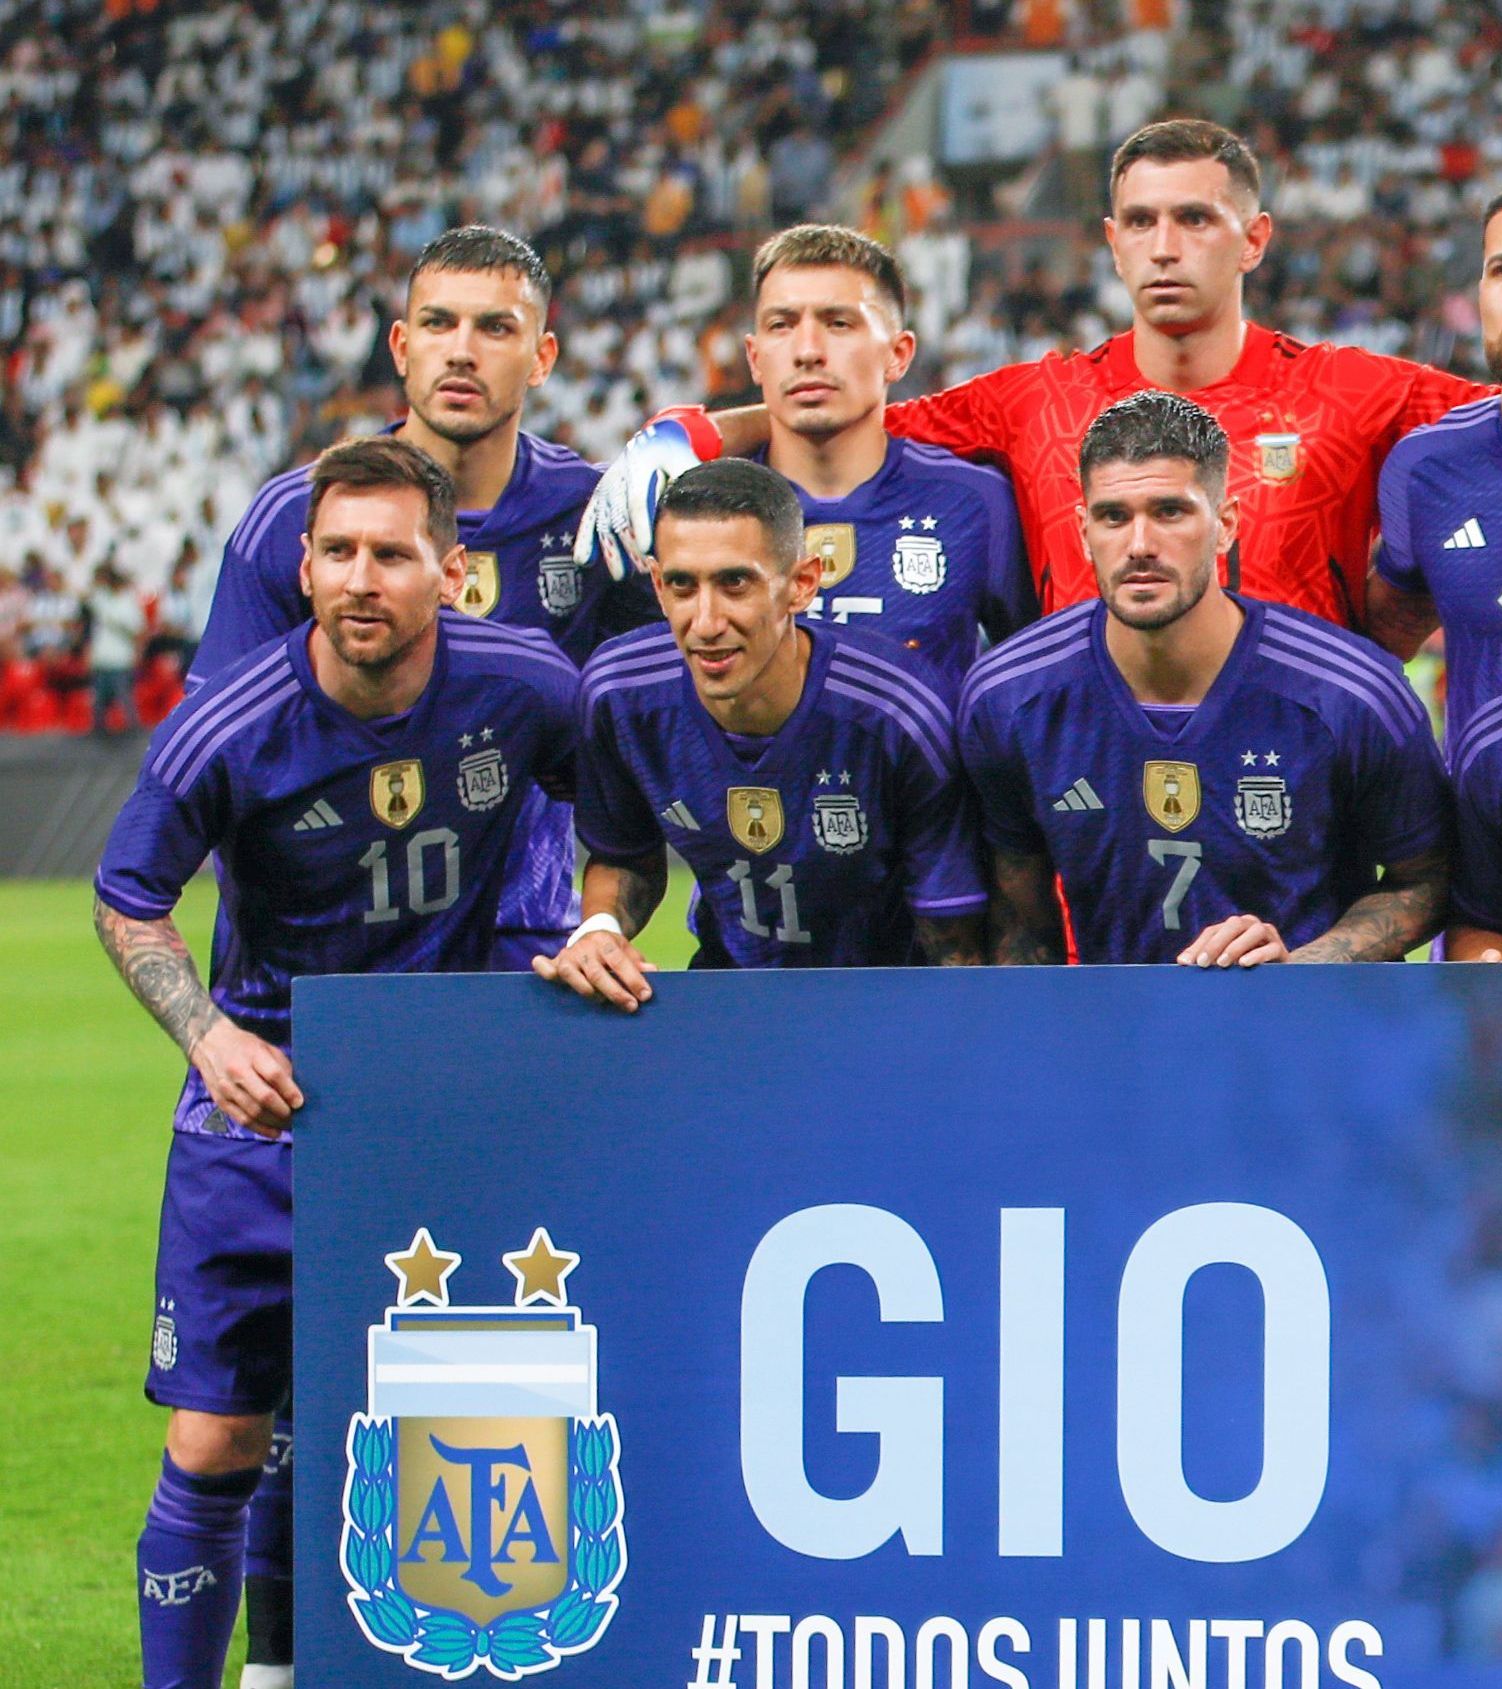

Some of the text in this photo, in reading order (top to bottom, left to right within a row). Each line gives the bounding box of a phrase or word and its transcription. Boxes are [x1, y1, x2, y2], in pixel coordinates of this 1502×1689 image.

[906, 552, 933, 577] AFA
[470, 767, 497, 793] AFA
[1248, 793, 1279, 821] AFA
[826, 811, 855, 837] AFA
[358, 827, 460, 924] 10
[726, 860, 812, 943] 11
[1148, 838, 1203, 930] 7
[740, 1201, 1331, 1563] GIO
[399, 1432, 561, 1598] AFA
[143, 1565, 217, 1606] AFA
[687, 1614, 1031, 1689] #TODOS
